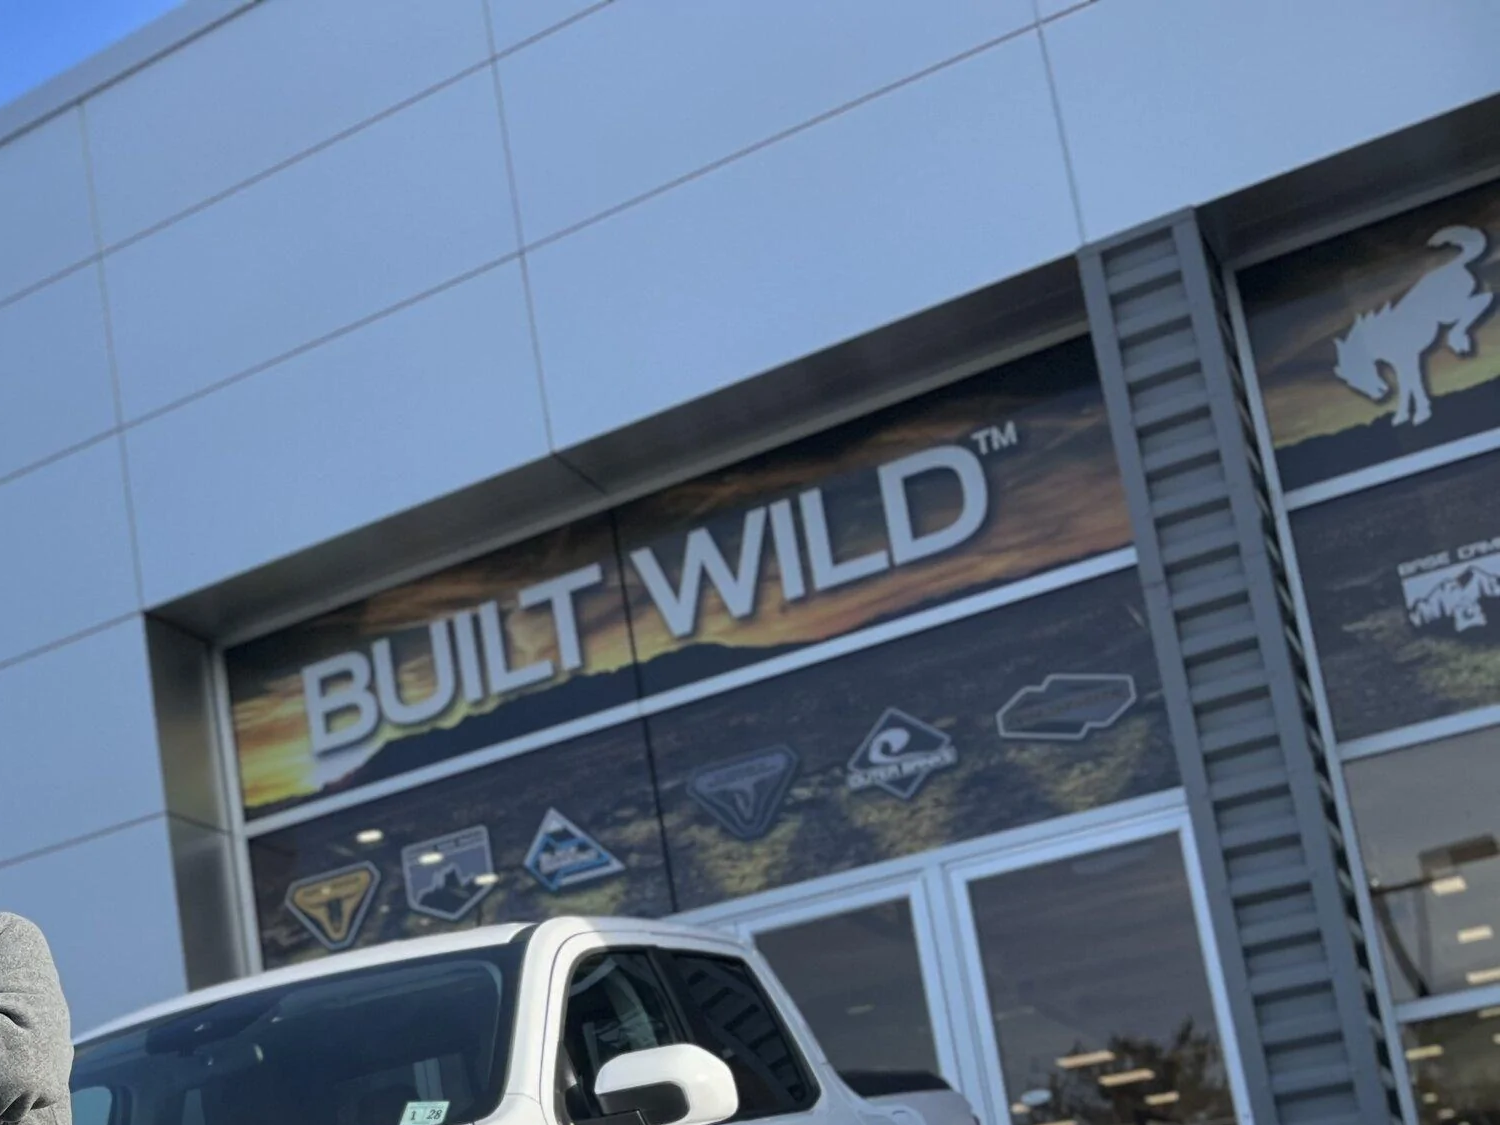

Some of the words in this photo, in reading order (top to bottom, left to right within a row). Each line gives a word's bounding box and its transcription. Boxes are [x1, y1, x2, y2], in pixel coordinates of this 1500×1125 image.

[301, 562, 601, 757] BUILT
[629, 444, 988, 648] WILD
[1396, 551, 1451, 577] BASE
[1456, 536, 1500, 561] CAM
